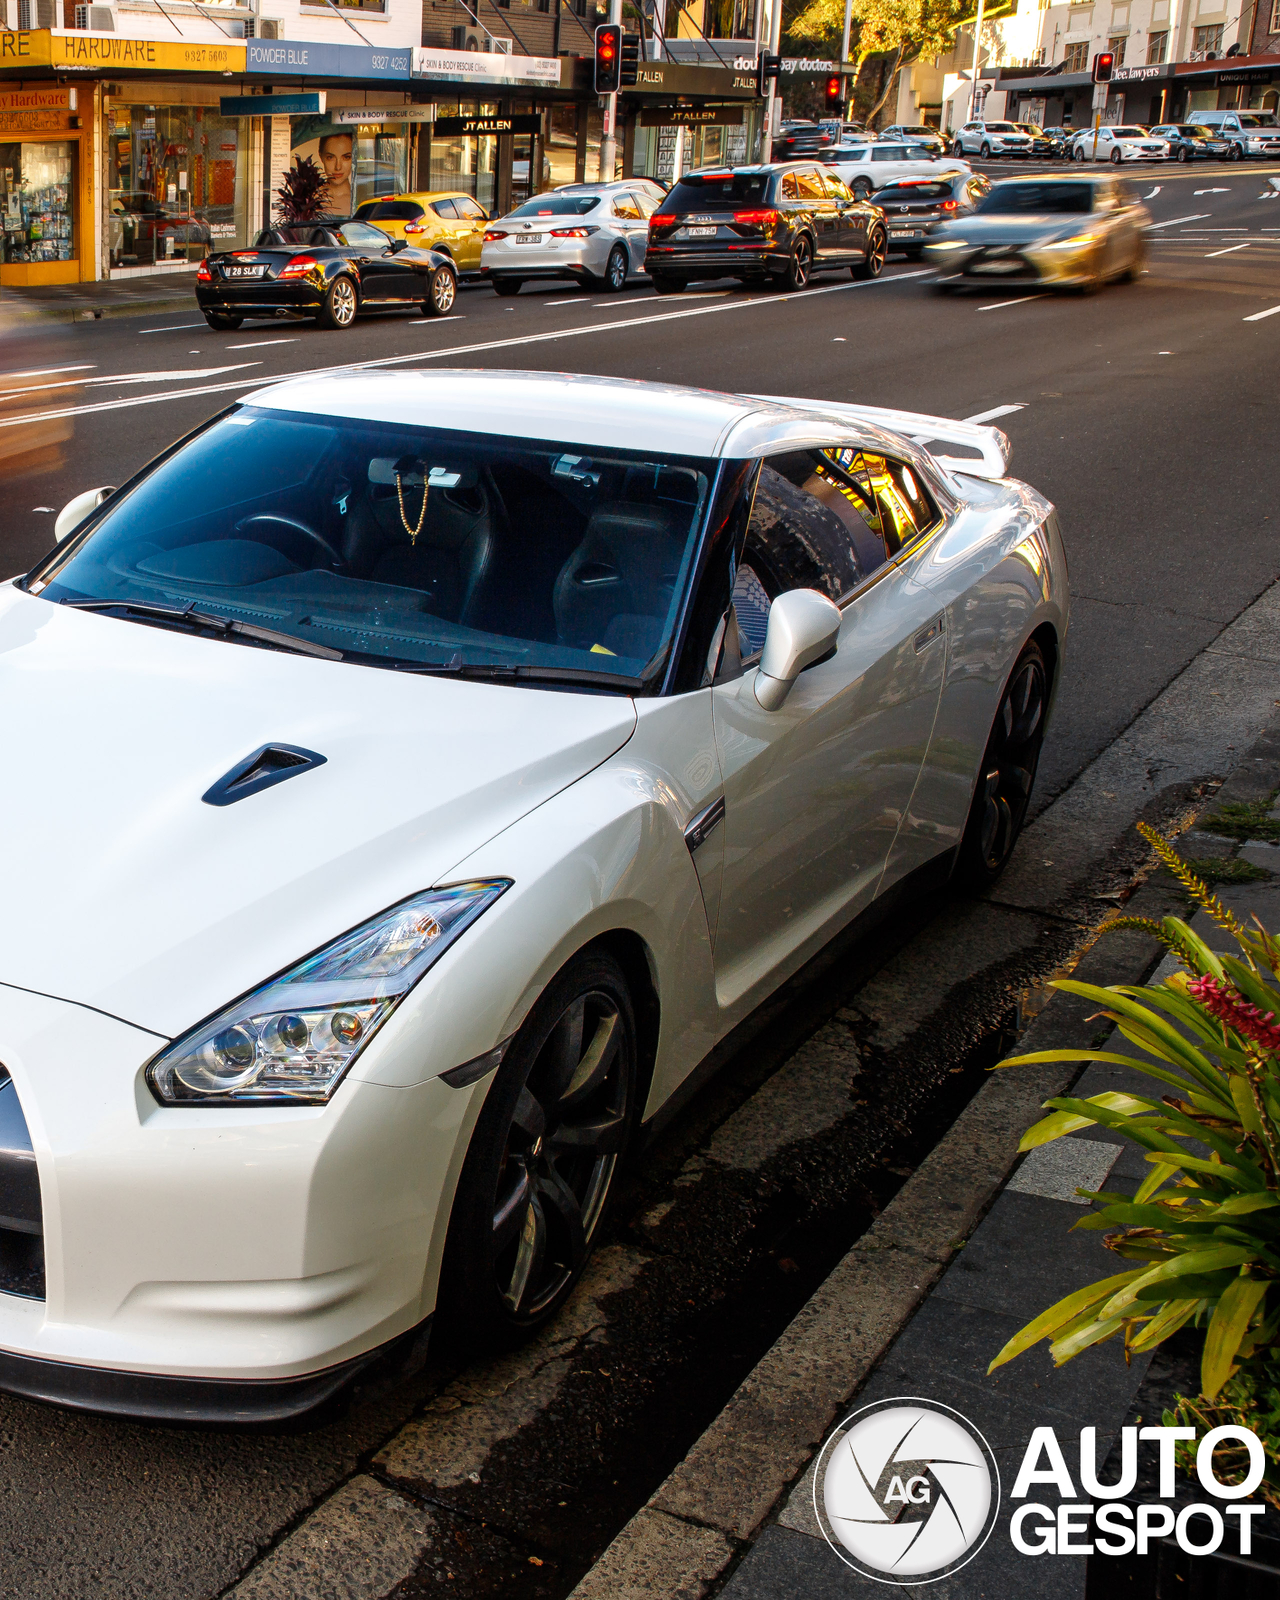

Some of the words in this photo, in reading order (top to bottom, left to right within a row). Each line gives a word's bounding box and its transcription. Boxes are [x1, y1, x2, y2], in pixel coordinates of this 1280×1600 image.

[65, 37, 156, 62] HARDWARE
[185, 50, 206, 62] 9327
[209, 51, 228, 62] 5603
[250, 48, 286, 64] POWDER
[288, 50, 309, 65] BLUE
[372, 55, 390, 69] 9327
[391, 57, 408, 71] 4252
[733, 56, 758, 70] dou
[800, 58, 833, 71] doctors
[426, 59, 437, 69] SKIN
[438, 60, 442, 69] &
[442, 60, 456, 70] BODY
[456, 61, 474, 72] RESCUE
[474, 62, 487, 73] Clinic
[642, 71, 664, 83] ALLEN
[1220, 73, 1249, 82] UNIQUE
[740, 78, 757, 89] ALLEN
[11, 93, 67, 108] Hardware
[272, 104, 299, 113] POWDER
[300, 103, 317, 112] BLUE
[386, 110, 408, 118] RESCUE
[409, 109, 425, 118] Clinic
[670, 112, 683, 121] JT
[683, 112, 716, 120] ALLEN
[463, 121, 475, 131] JT
[474, 121, 511, 131] ALLEN
[232, 267, 241, 275] 28
[243, 267, 257, 275] SLK
